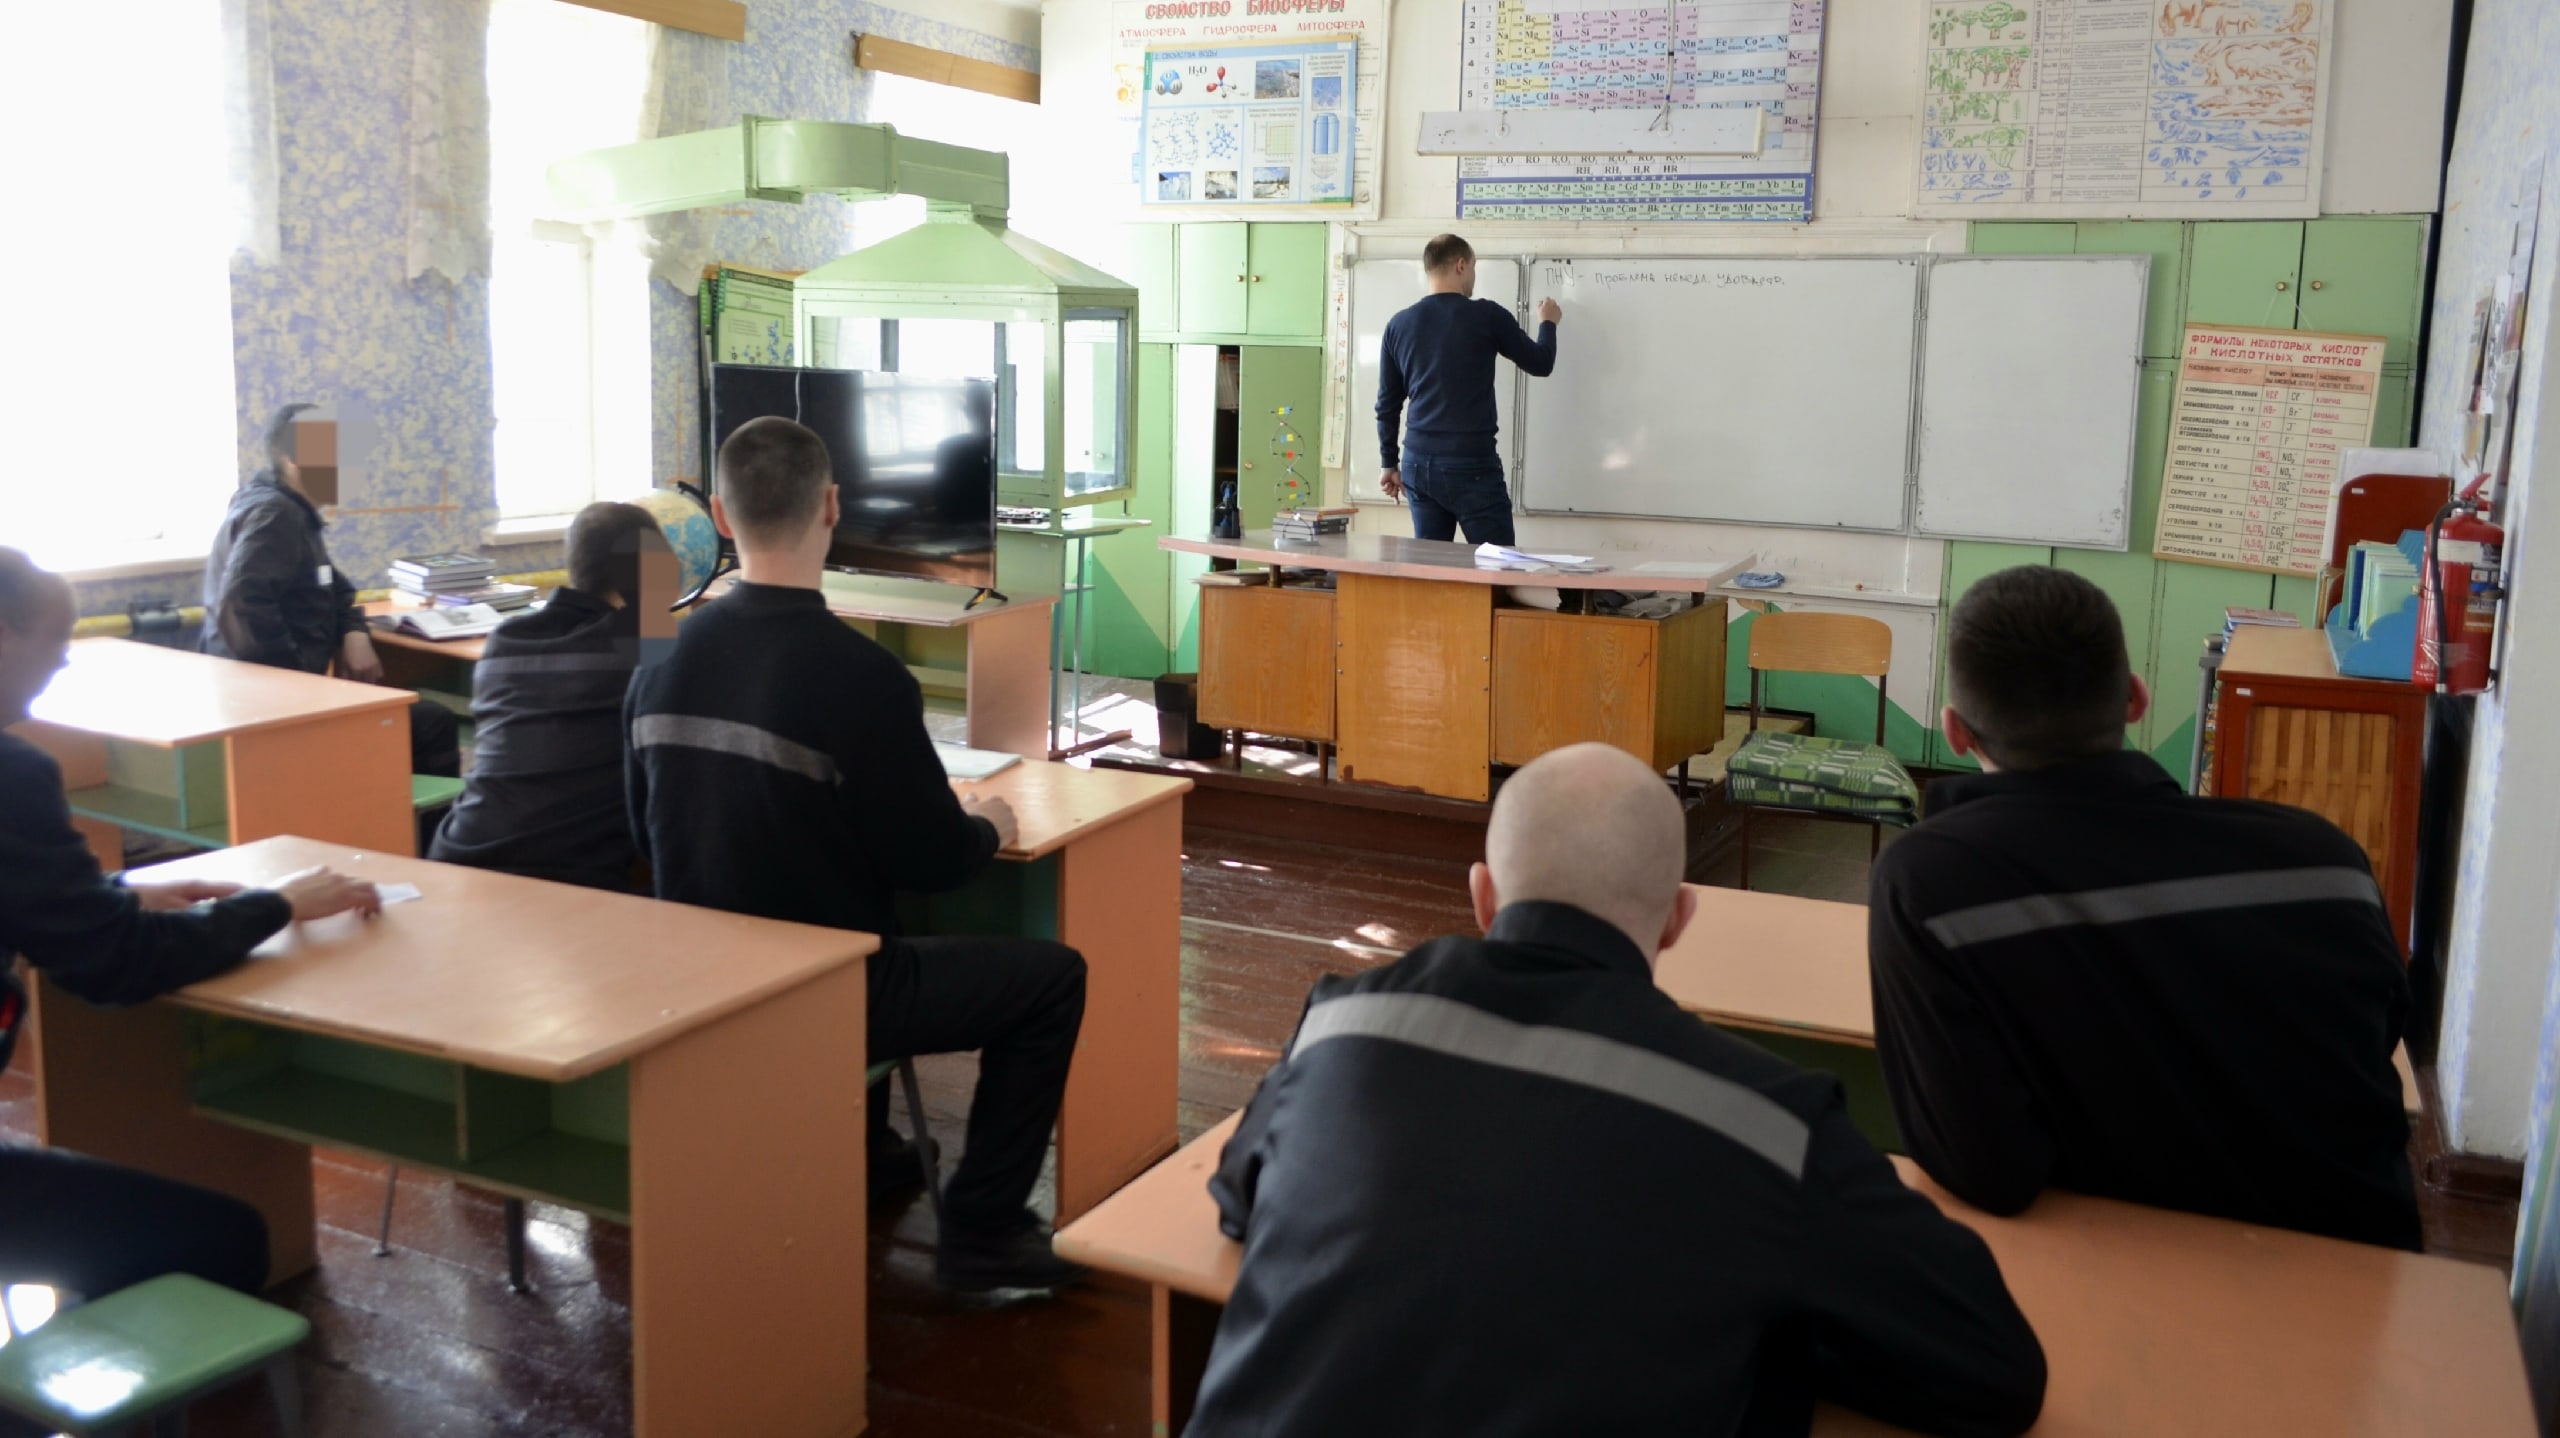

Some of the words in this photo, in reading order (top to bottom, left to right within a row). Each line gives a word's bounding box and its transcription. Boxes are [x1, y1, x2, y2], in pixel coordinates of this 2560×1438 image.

[1146, 0, 1231, 19] СВОЙСТВО
[1246, 0, 1345, 15] БИОСФЕРЫ
[1469, 21, 1476, 29] 2
[1485, 21, 1492, 29] 2
[1581, 12, 1589, 21] C
[1639, 9, 1647, 18] O
[1119, 27, 1186, 38] АТМОСФЕРА
[1203, 24, 1277, 36] ГИДРОСФЕРА
[1297, 20, 1365, 31] ЛИТОСФЕРА
[1654, 41, 1666, 49] Cr
[1681, 39, 1696, 47] Mn
[1716, 38, 1727, 46] Fe
[1199, 49, 1218, 58] ВОДЫ
[1510, 62, 1522, 70] Cu
[1538, 61, 1550, 69] Zn
[1551, 61, 1564, 69] Ga
[1467, 90, 1473, 98] 5
[1650, 73, 1665, 81] Mo
[2191, 334, 2244, 347] ФОРМУЛЫ
[2250, 338, 2312, 352] НЕКОТОРЫХ
[2321, 343, 2368, 355] КИСЛОТ
[2189, 347, 2197, 355] И
[2210, 348, 2293, 363] КИСЛОТНЫХ
[2302, 355, 2362, 367] ОСТАТКОВ
[2188, 363, 2221, 372] НАЗВАНИЕ
[2224, 366, 2253, 375] КИСЛОТ
[2170, 489, 2207, 497] СЕРНИСТАЯ
